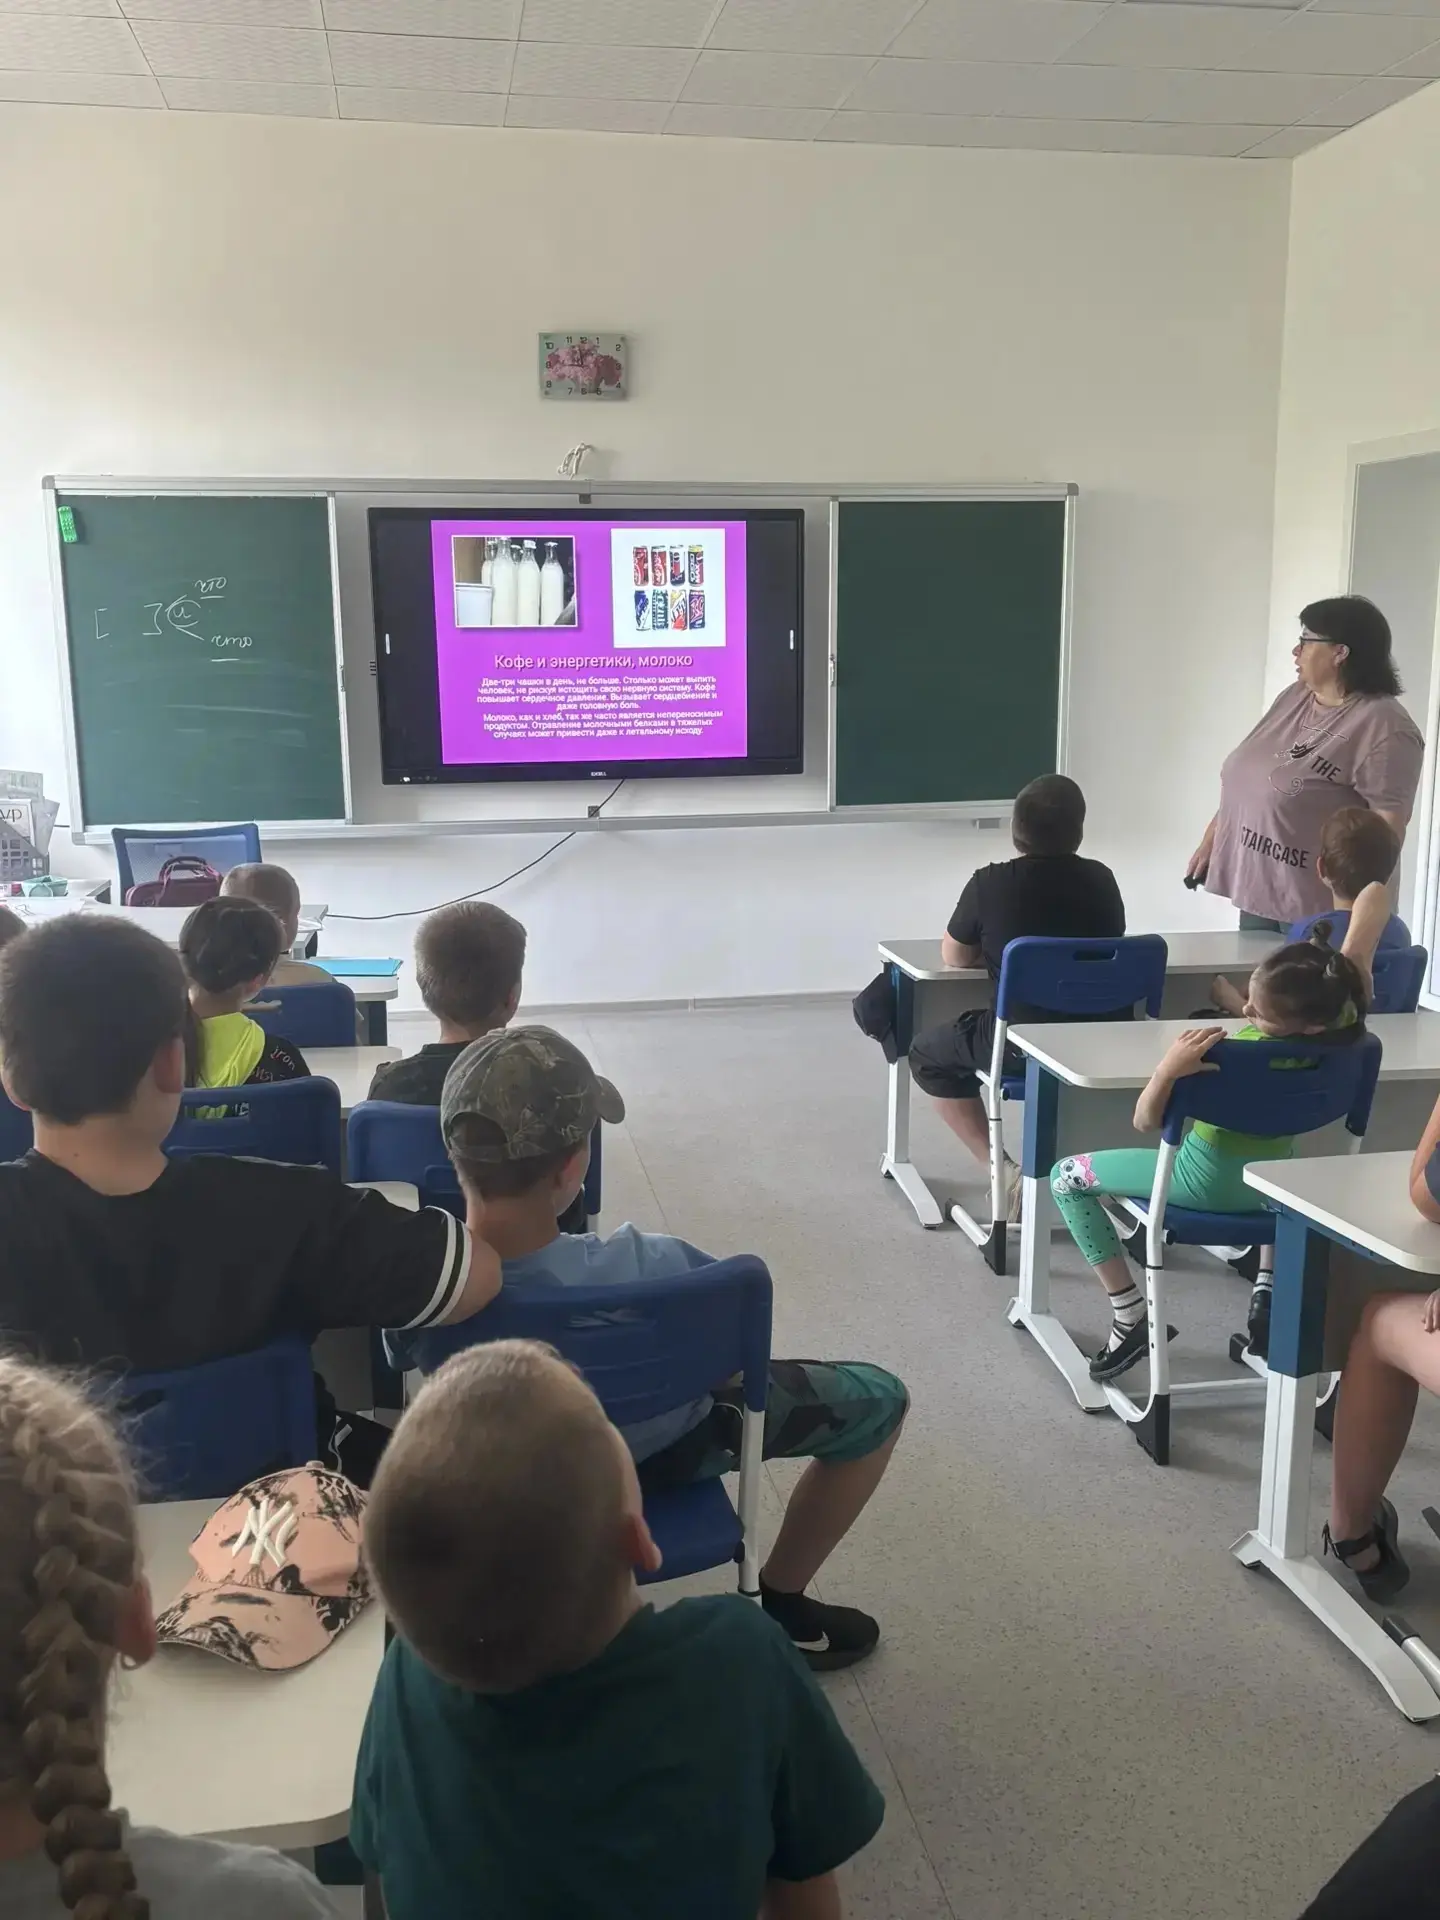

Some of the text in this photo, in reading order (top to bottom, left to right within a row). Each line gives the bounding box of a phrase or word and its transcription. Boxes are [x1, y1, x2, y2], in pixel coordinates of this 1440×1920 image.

[546, 380, 552, 388] 8
[567, 387, 573, 395] 7
[494, 654, 693, 671] Кофе и энергетики, молоко
[482, 677, 515, 688] Две-три
[516, 678, 544, 686] чашки
[552, 678, 575, 687] день,
[588, 676, 621, 685] больше.
[623, 675, 657, 684] Столько
[477, 687, 515, 695] человек,
[528, 687, 557, 696] рискуя
[558, 686, 598, 694] истощить
[622, 685, 658, 694] нервную
[658, 684, 693, 693] систему.
[694, 683, 717, 693] Кофе
[476, 695, 520, 703] повышает
[521, 694, 565, 704] сердечное
[567, 694, 609, 703] давление.
[610, 692, 652, 701] Вызывает
[653, 692, 710, 702] сердцебиение
[556, 700, 641, 711] даже головную боль.
[483, 713, 517, 722] Молоко,
[542, 712, 564, 722] хлеб,
[618, 712, 655, 720] является
[656, 710, 724, 719] непереносимым
[483, 722, 531, 732] продуктом.
[531, 721, 582, 731] Отравление
[583, 721, 632, 729] молочными
[633, 719, 669, 727] белками
[677, 718, 714, 726] тяжелых
[493, 726, 704, 740] случаях может привести даже к летальному исходу.
[1310, 755, 1341, 782] THE
